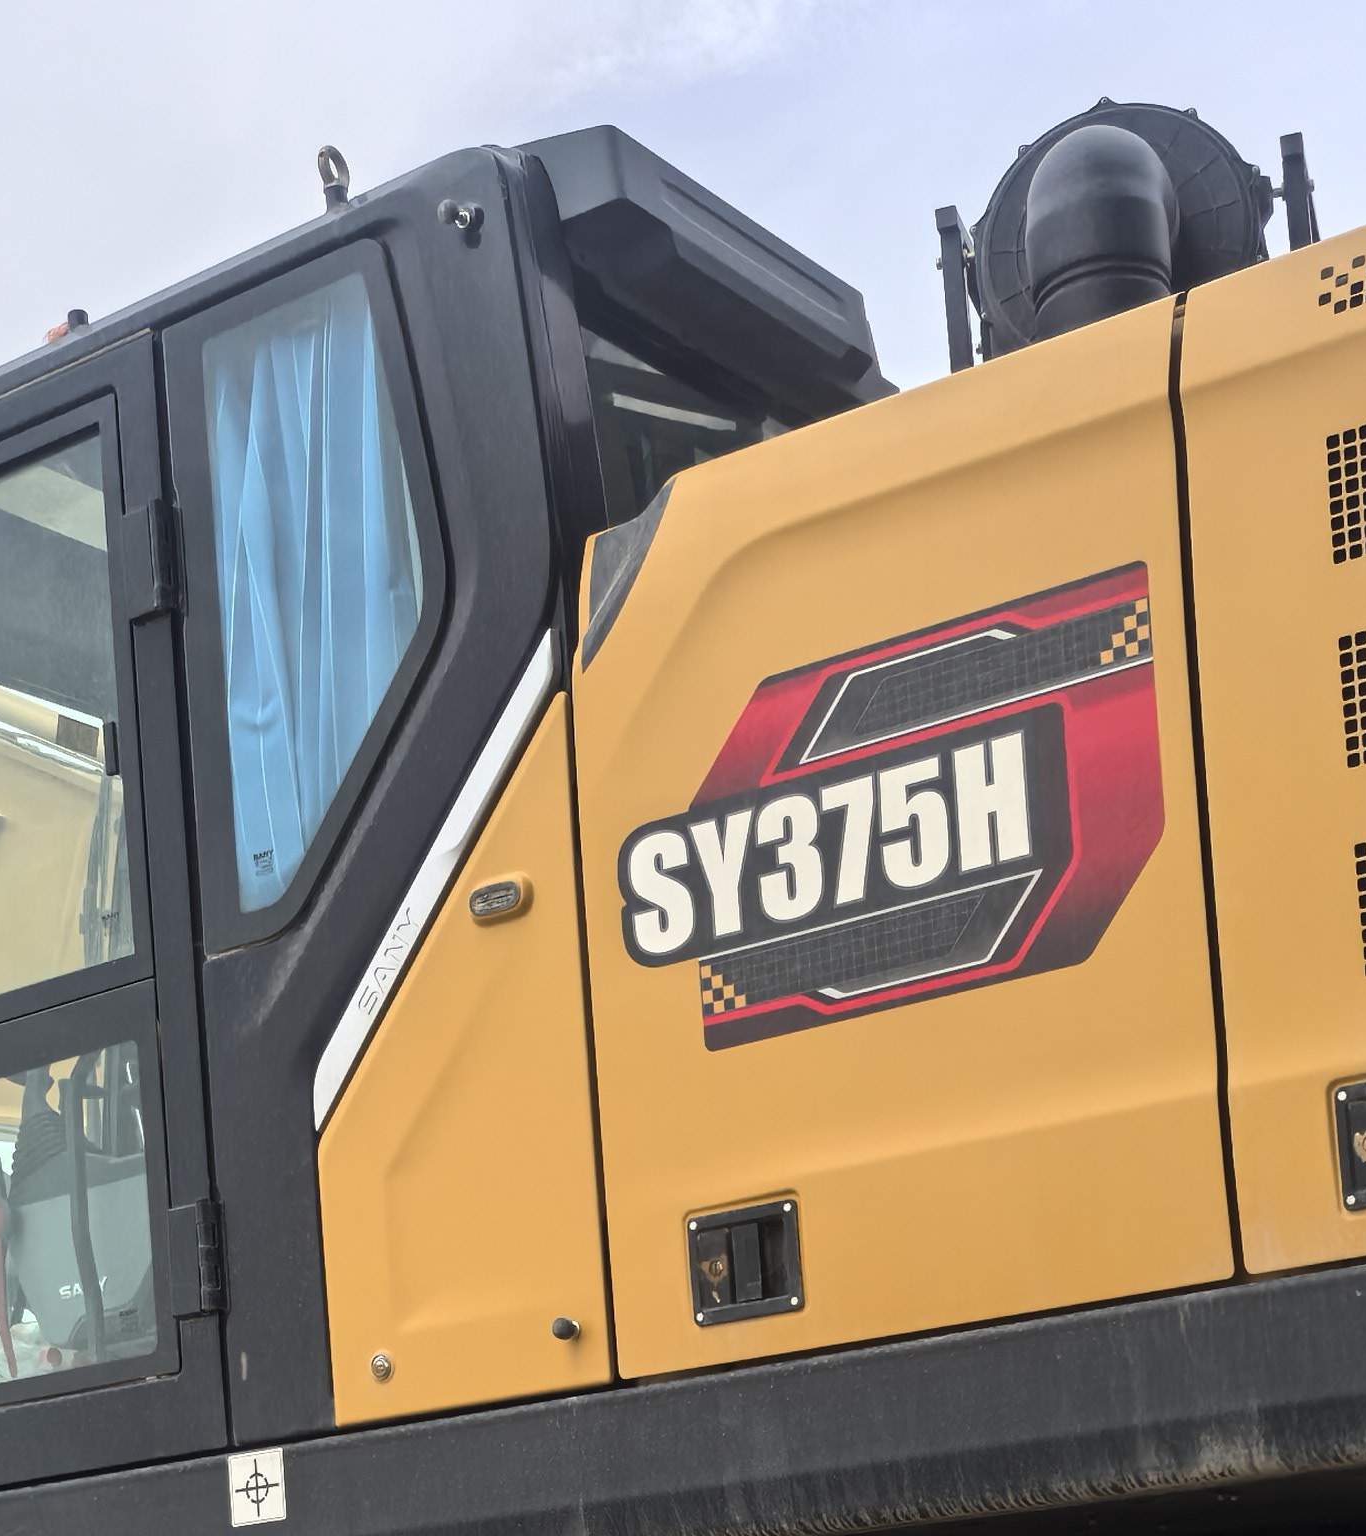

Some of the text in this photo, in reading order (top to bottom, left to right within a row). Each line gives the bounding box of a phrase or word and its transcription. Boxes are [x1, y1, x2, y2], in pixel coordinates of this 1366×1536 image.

[627, 730, 1032, 956] SY375H
[358, 906, 419, 1016] SANY
[58, 1276, 107, 1299] SAY
